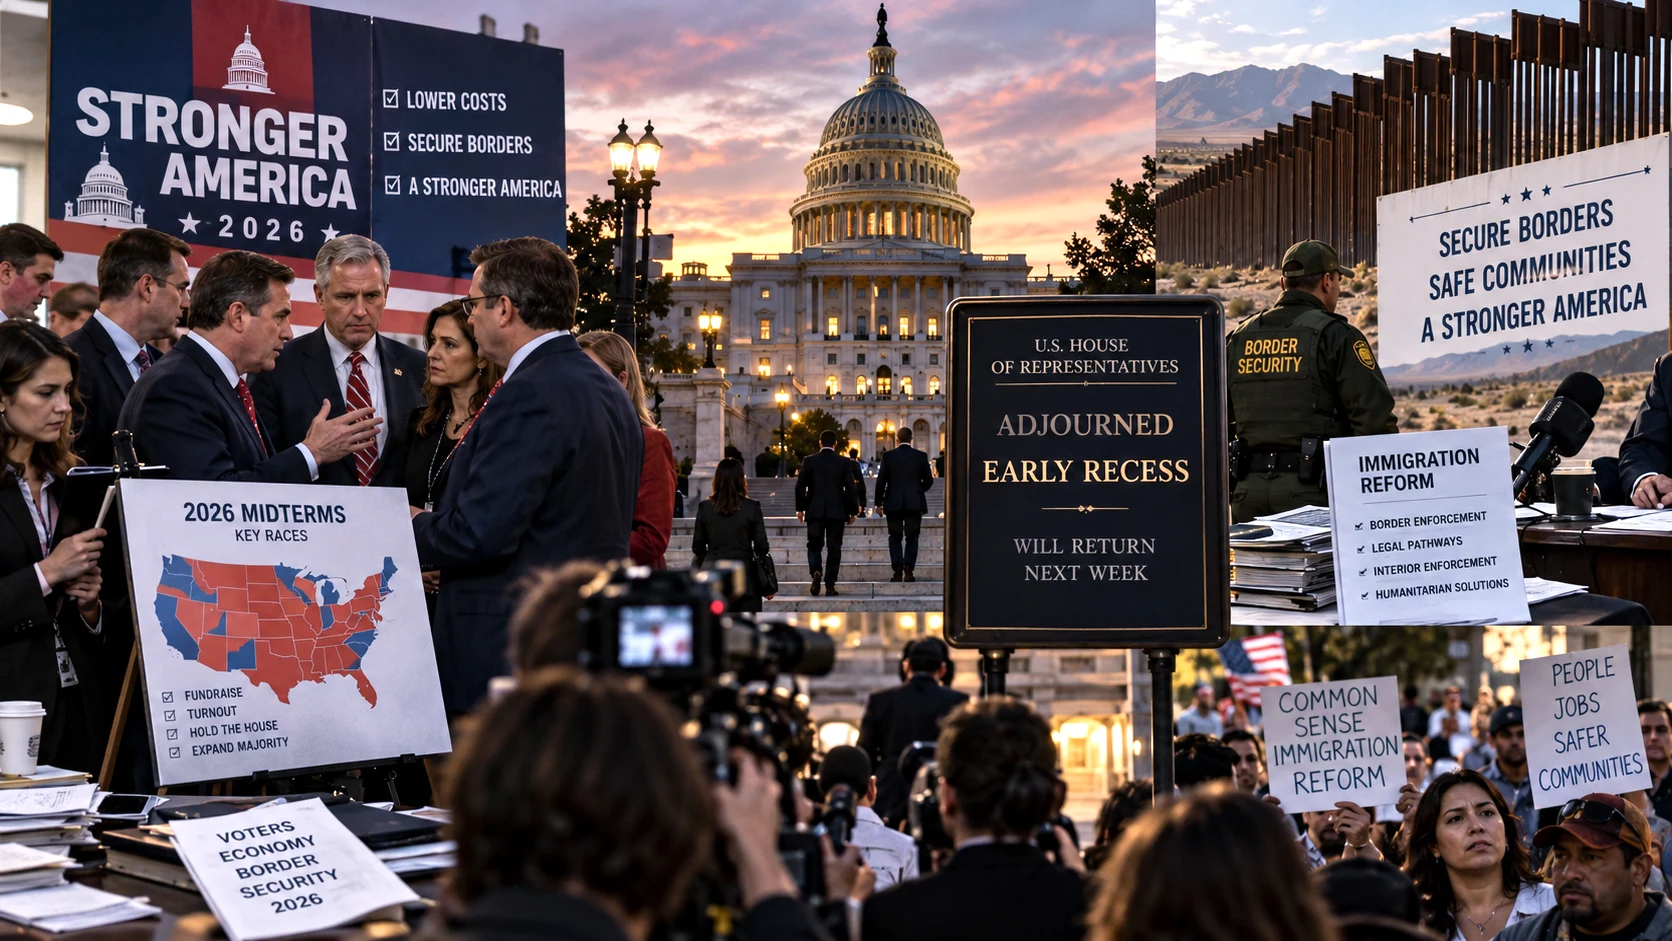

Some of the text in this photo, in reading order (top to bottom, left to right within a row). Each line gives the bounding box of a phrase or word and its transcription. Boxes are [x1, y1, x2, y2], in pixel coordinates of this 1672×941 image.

[407, 90, 507, 112] LOWER COSTS
[76, 86, 349, 162] STRONGER
[408, 133, 533, 154] SECURE BORDERS
[160, 152, 357, 210] AMERICA
[409, 177, 562, 199] A STRONGER AMERICA
[218, 214, 304, 243] 2026
[1439, 199, 1613, 257] SECURE BORDERS
[1430, 240, 1631, 300] SAFE COMMUNITIES
[1421, 282, 1647, 343] A STRONGER AMERICA
[1035, 339, 1128, 352] U.S. HOUSE
[1245, 338, 1298, 355] BORDER
[991, 360, 1178, 375] OF REPRESENTATIVES
[1238, 357, 1302, 374] SECURITY
[996, 414, 1173, 436] ADJOURNED
[983, 459, 1189, 483] EARLY RECESS
[1359, 448, 1480, 472] IMMIGRATION
[1361, 473, 1434, 493] REFORM
[184, 502, 346, 523] 2026 MIDTERMS
[1370, 511, 1487, 530] BORDER ENFORCEMENT
[236, 529, 308, 542] KEY RACES
[1014, 538, 1155, 554] WILL RETURN
[1372, 536, 1463, 553] LEGAL PATHWAYS
[1025, 565, 1148, 581] NEXT WEEK
[1374, 556, 1497, 576] INTERIOR ENFORCEMENT
[1376, 579, 1509, 600] HUMANITARIAN SOLUTIONS
[1553, 656, 1615, 686] PEOPLE
[185, 687, 243, 701] FUNDRAISE
[1279, 685, 1377, 713] COMMON
[187, 706, 237, 720] TURNOUT
[1554, 692, 1600, 720] JOBS
[190, 720, 278, 738] HOLD THE HOUSE
[1295, 712, 1365, 737] SENSE
[192, 737, 288, 756] EXPAND MAJORITY
[1274, 735, 1398, 766] IMMIGRATION
[1554, 725, 1610, 754] SAFER
[1294, 765, 1386, 795] REFORM
[1538, 753, 1643, 792] COMMUNITIES
[217, 821, 295, 844] VOTERS
[219, 835, 316, 864] ECONOMY
[235, 854, 319, 880] BORDER
[240, 868, 339, 900] SECURITY
[271, 893, 323, 914] 2026
